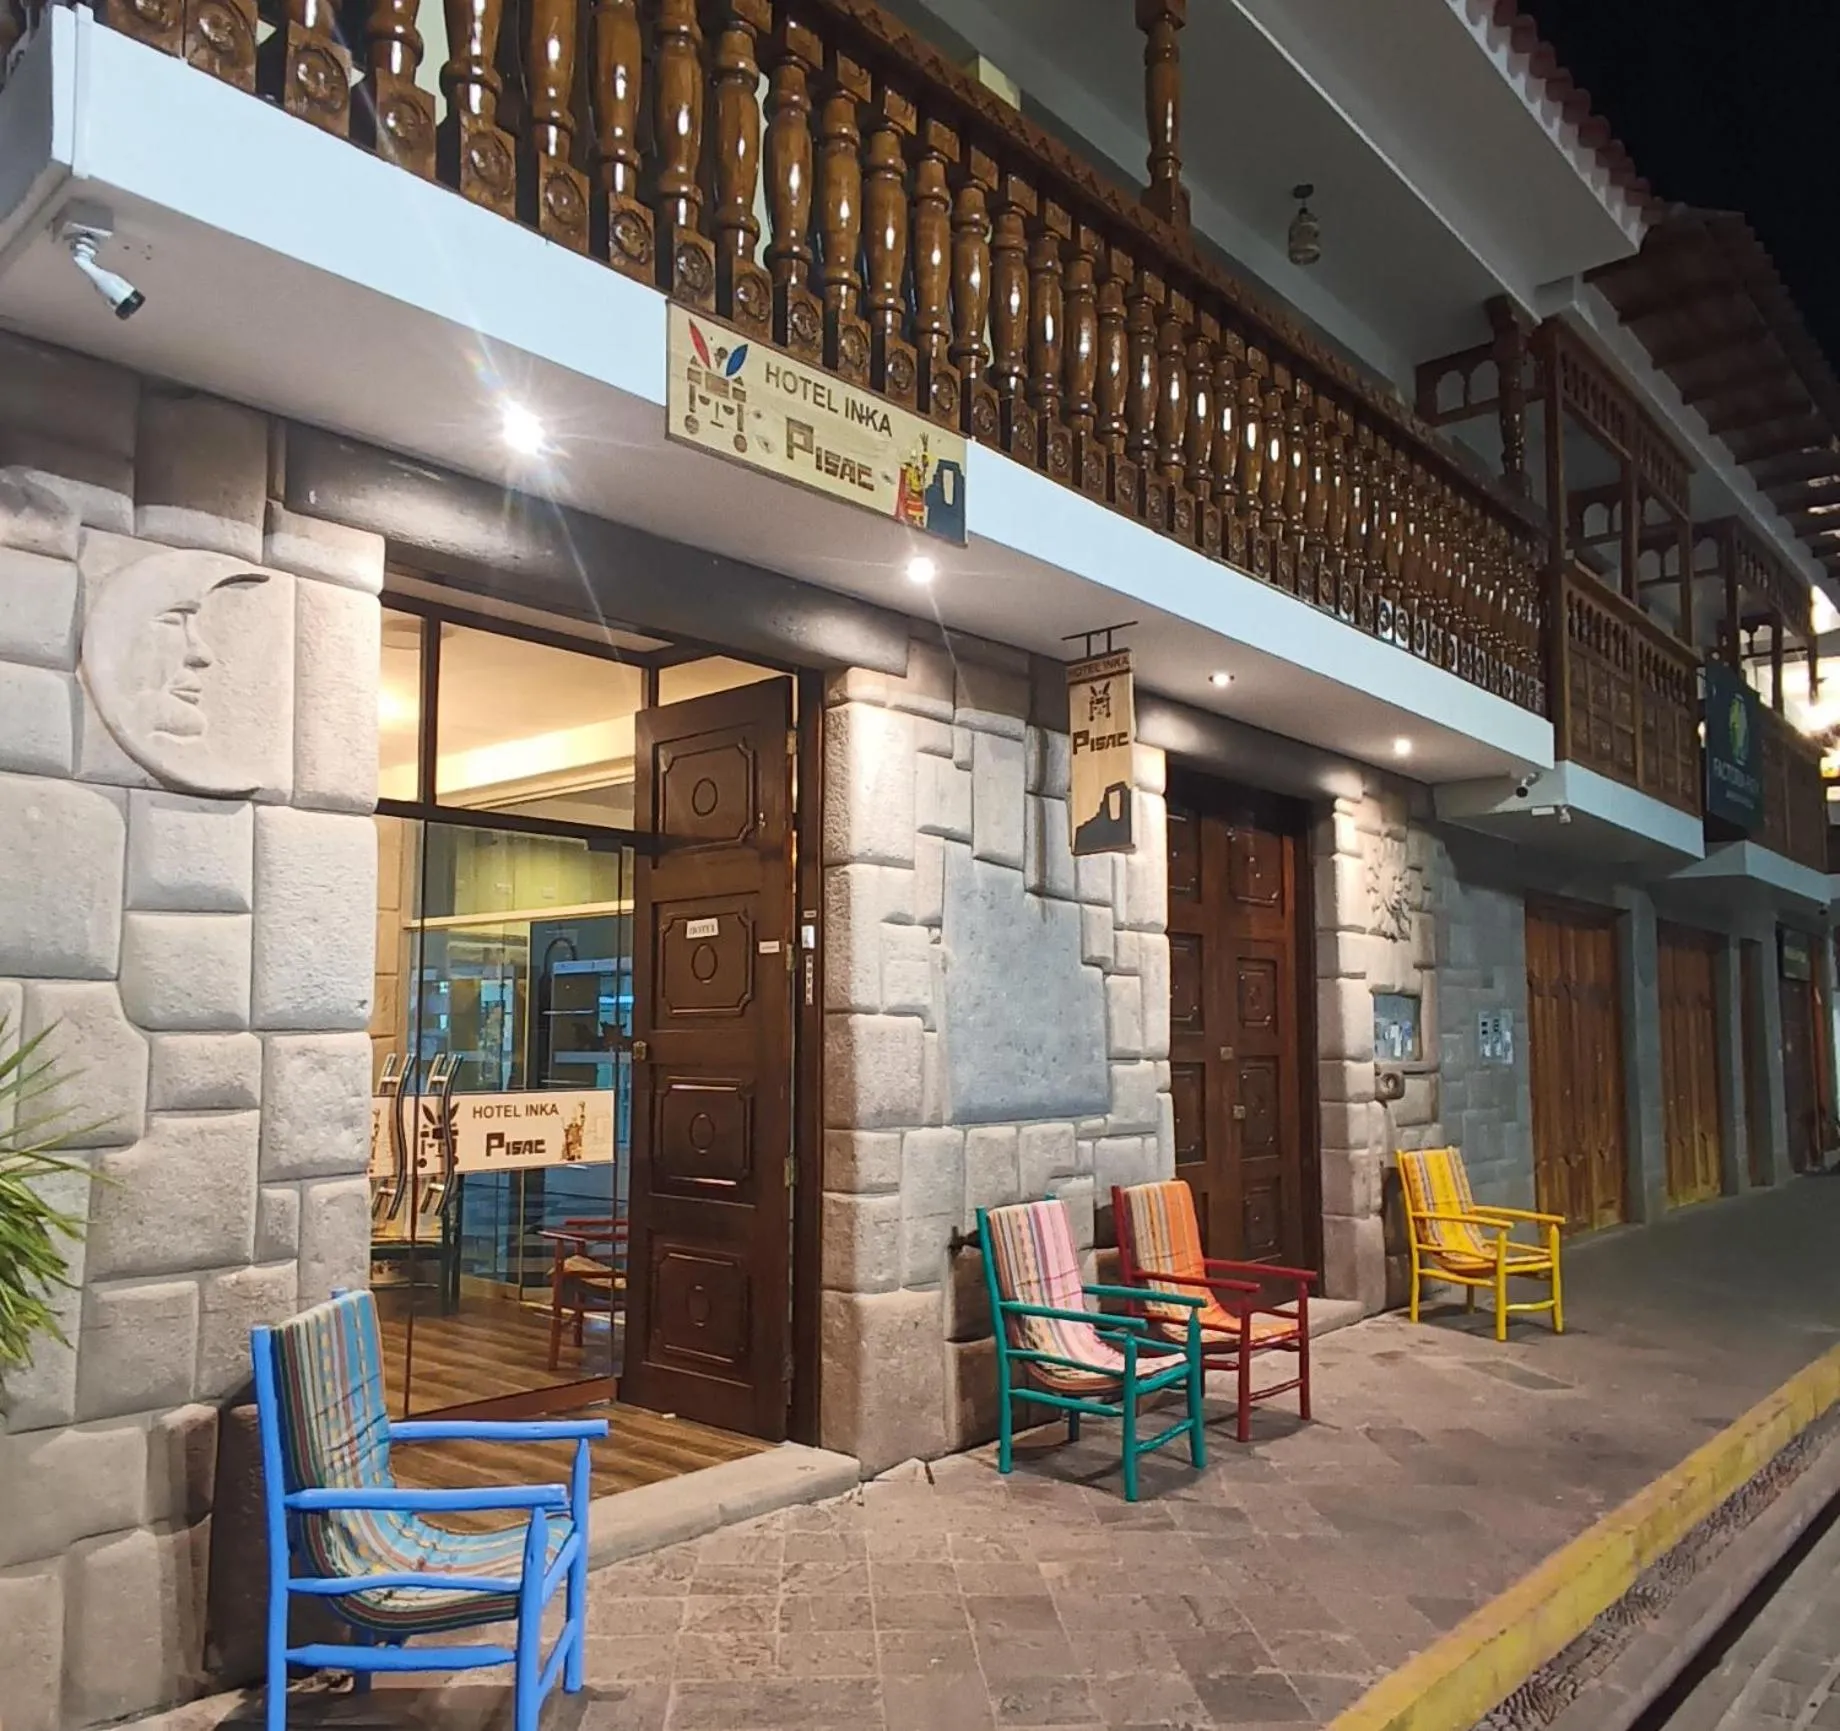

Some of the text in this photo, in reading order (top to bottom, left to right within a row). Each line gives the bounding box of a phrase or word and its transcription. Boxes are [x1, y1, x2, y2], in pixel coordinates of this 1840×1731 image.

[764, 361, 893, 438] HOTEL INKA
[785, 416, 875, 491] PISAC
[1072, 729, 1129, 756] PISAC
[472, 1102, 560, 1119] HOTEL INKA
[485, 1131, 547, 1157] PISAC
